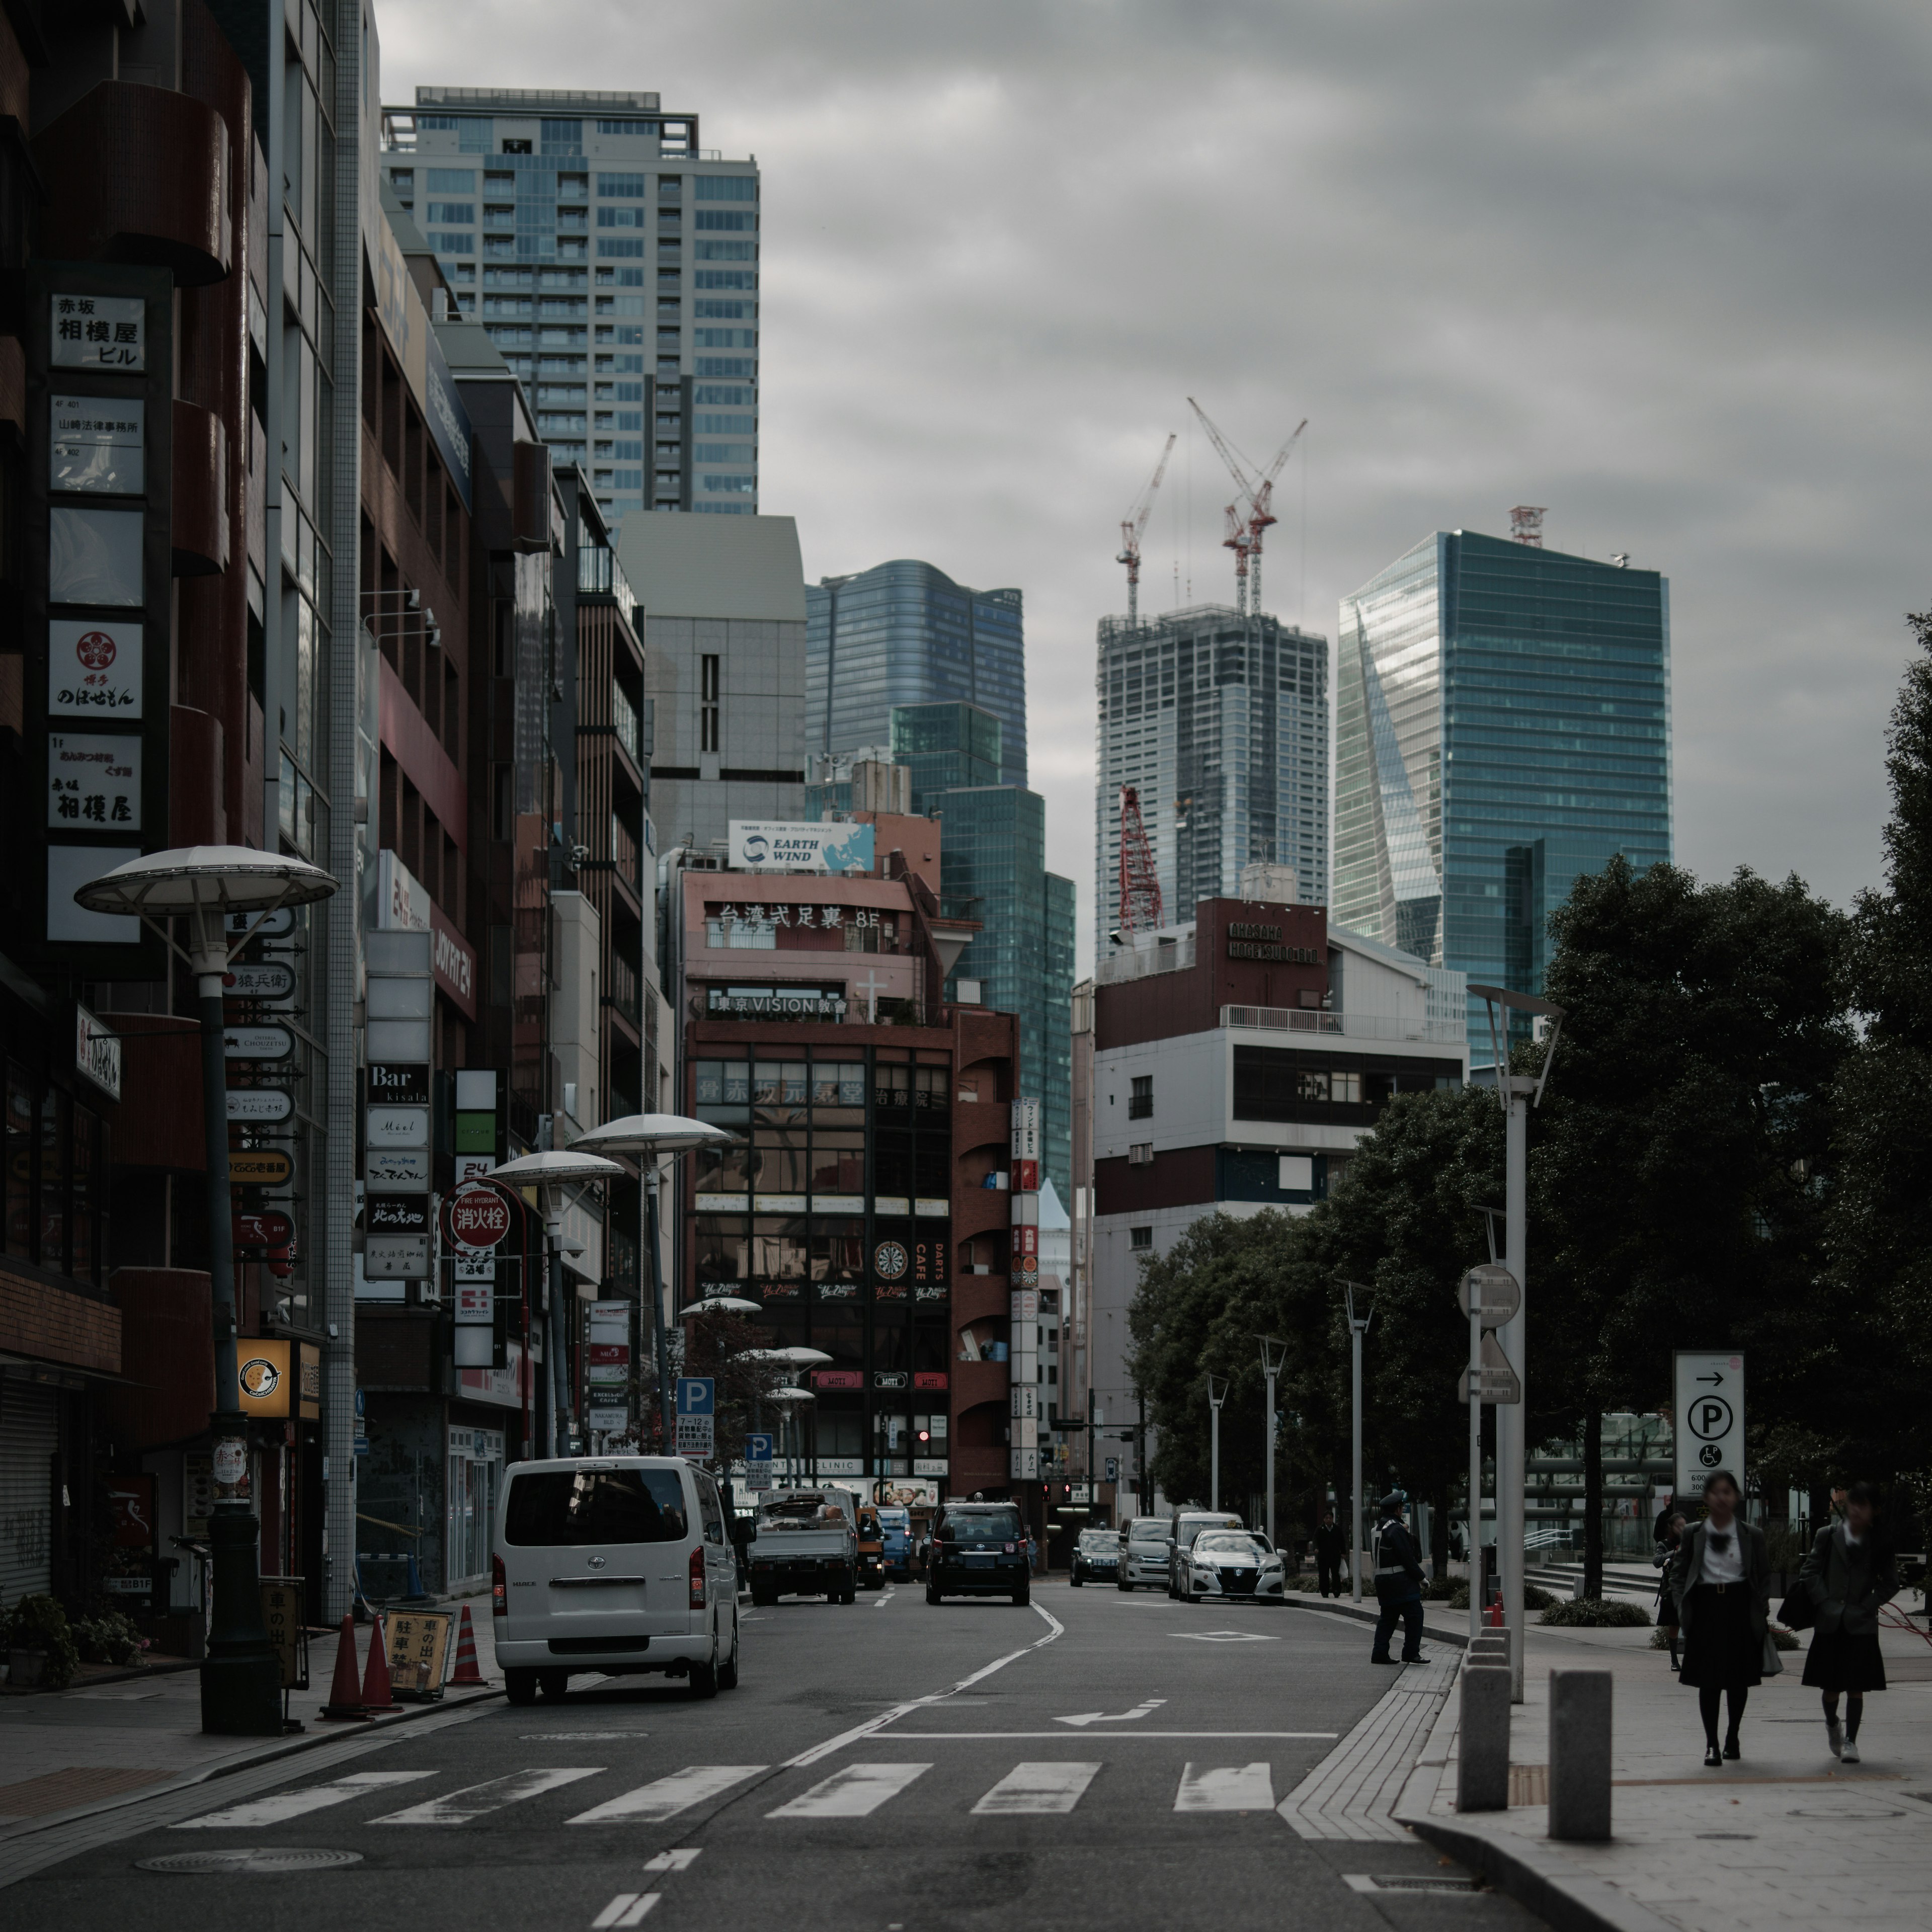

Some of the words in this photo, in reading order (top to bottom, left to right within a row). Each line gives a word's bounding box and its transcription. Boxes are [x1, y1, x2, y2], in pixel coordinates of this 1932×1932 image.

[58, 298, 95, 314] 赤坂
[59, 318, 137, 344] 相模屋
[100, 347, 137, 366] ビル
[84, 674, 108, 686] 博多
[58, 794, 132, 822] 相模屋
[773, 839, 820, 850] EARTH
[773, 851, 812, 861] WIND
[719, 905, 843, 929] 台湾式足裏
[856, 911, 880, 929] 8F
[1229, 922, 1283, 941] AKASAKA
[1229, 941, 1295, 961] HOGETSUDO
[238, 974, 287, 988] 猿兵衛
[371, 1067, 412, 1086] Bar
[387, 1092, 427, 1102] kisala
[464, 1163, 488, 1176] 24
[457, 1207, 505, 1230] 消火栓
[465, 1264, 485, 1275] 酒場
[916, 1244, 926, 1280] CAFE
[935, 1243, 943, 1280] DARTS
[828, 1377, 846, 1386] MOTI
[881, 1378, 898, 1386] MOTI
[922, 1379, 938, 1387] MOTI
[686, 1382, 707, 1411] P
[133, 1580, 151, 1588] B1F
